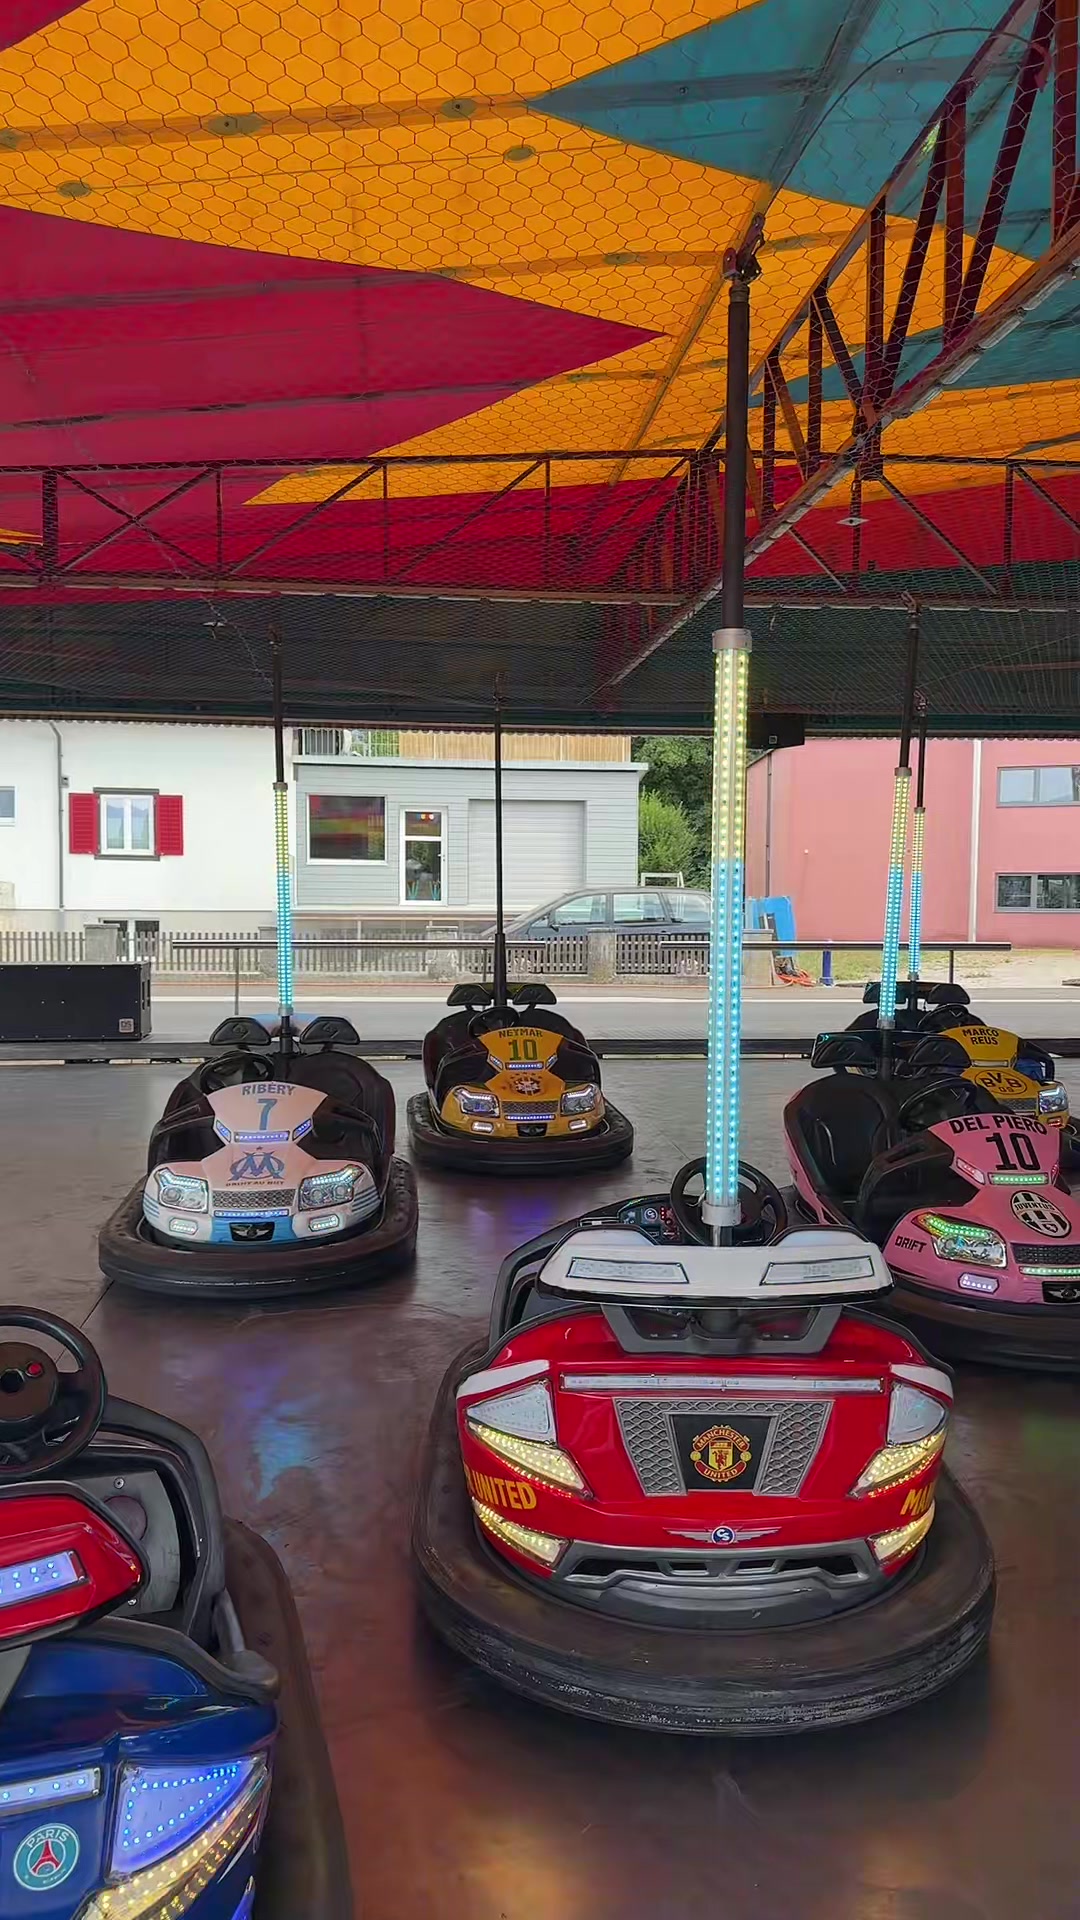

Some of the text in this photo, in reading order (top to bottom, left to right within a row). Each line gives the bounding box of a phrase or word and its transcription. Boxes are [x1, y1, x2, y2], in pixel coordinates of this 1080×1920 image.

[498, 1028, 543, 1038] NEYMAR
[962, 1028, 999, 1037] MARCO
[970, 1036, 998, 1046] REUS
[508, 1039, 538, 1061] 10
[257, 1098, 278, 1130] 7
[949, 1115, 1047, 1135] DEL PIERO
[985, 1132, 1041, 1171] 10
[1014, 1201, 1056, 1211] JUVENTUS
[894, 1235, 927, 1253] DRIFT
[696, 1429, 746, 1448] MANCHESTER
[703, 1468, 738, 1478] UNITED
[471, 1470, 537, 1510] UNITED
[26, 1829, 69, 1848] PARIS
